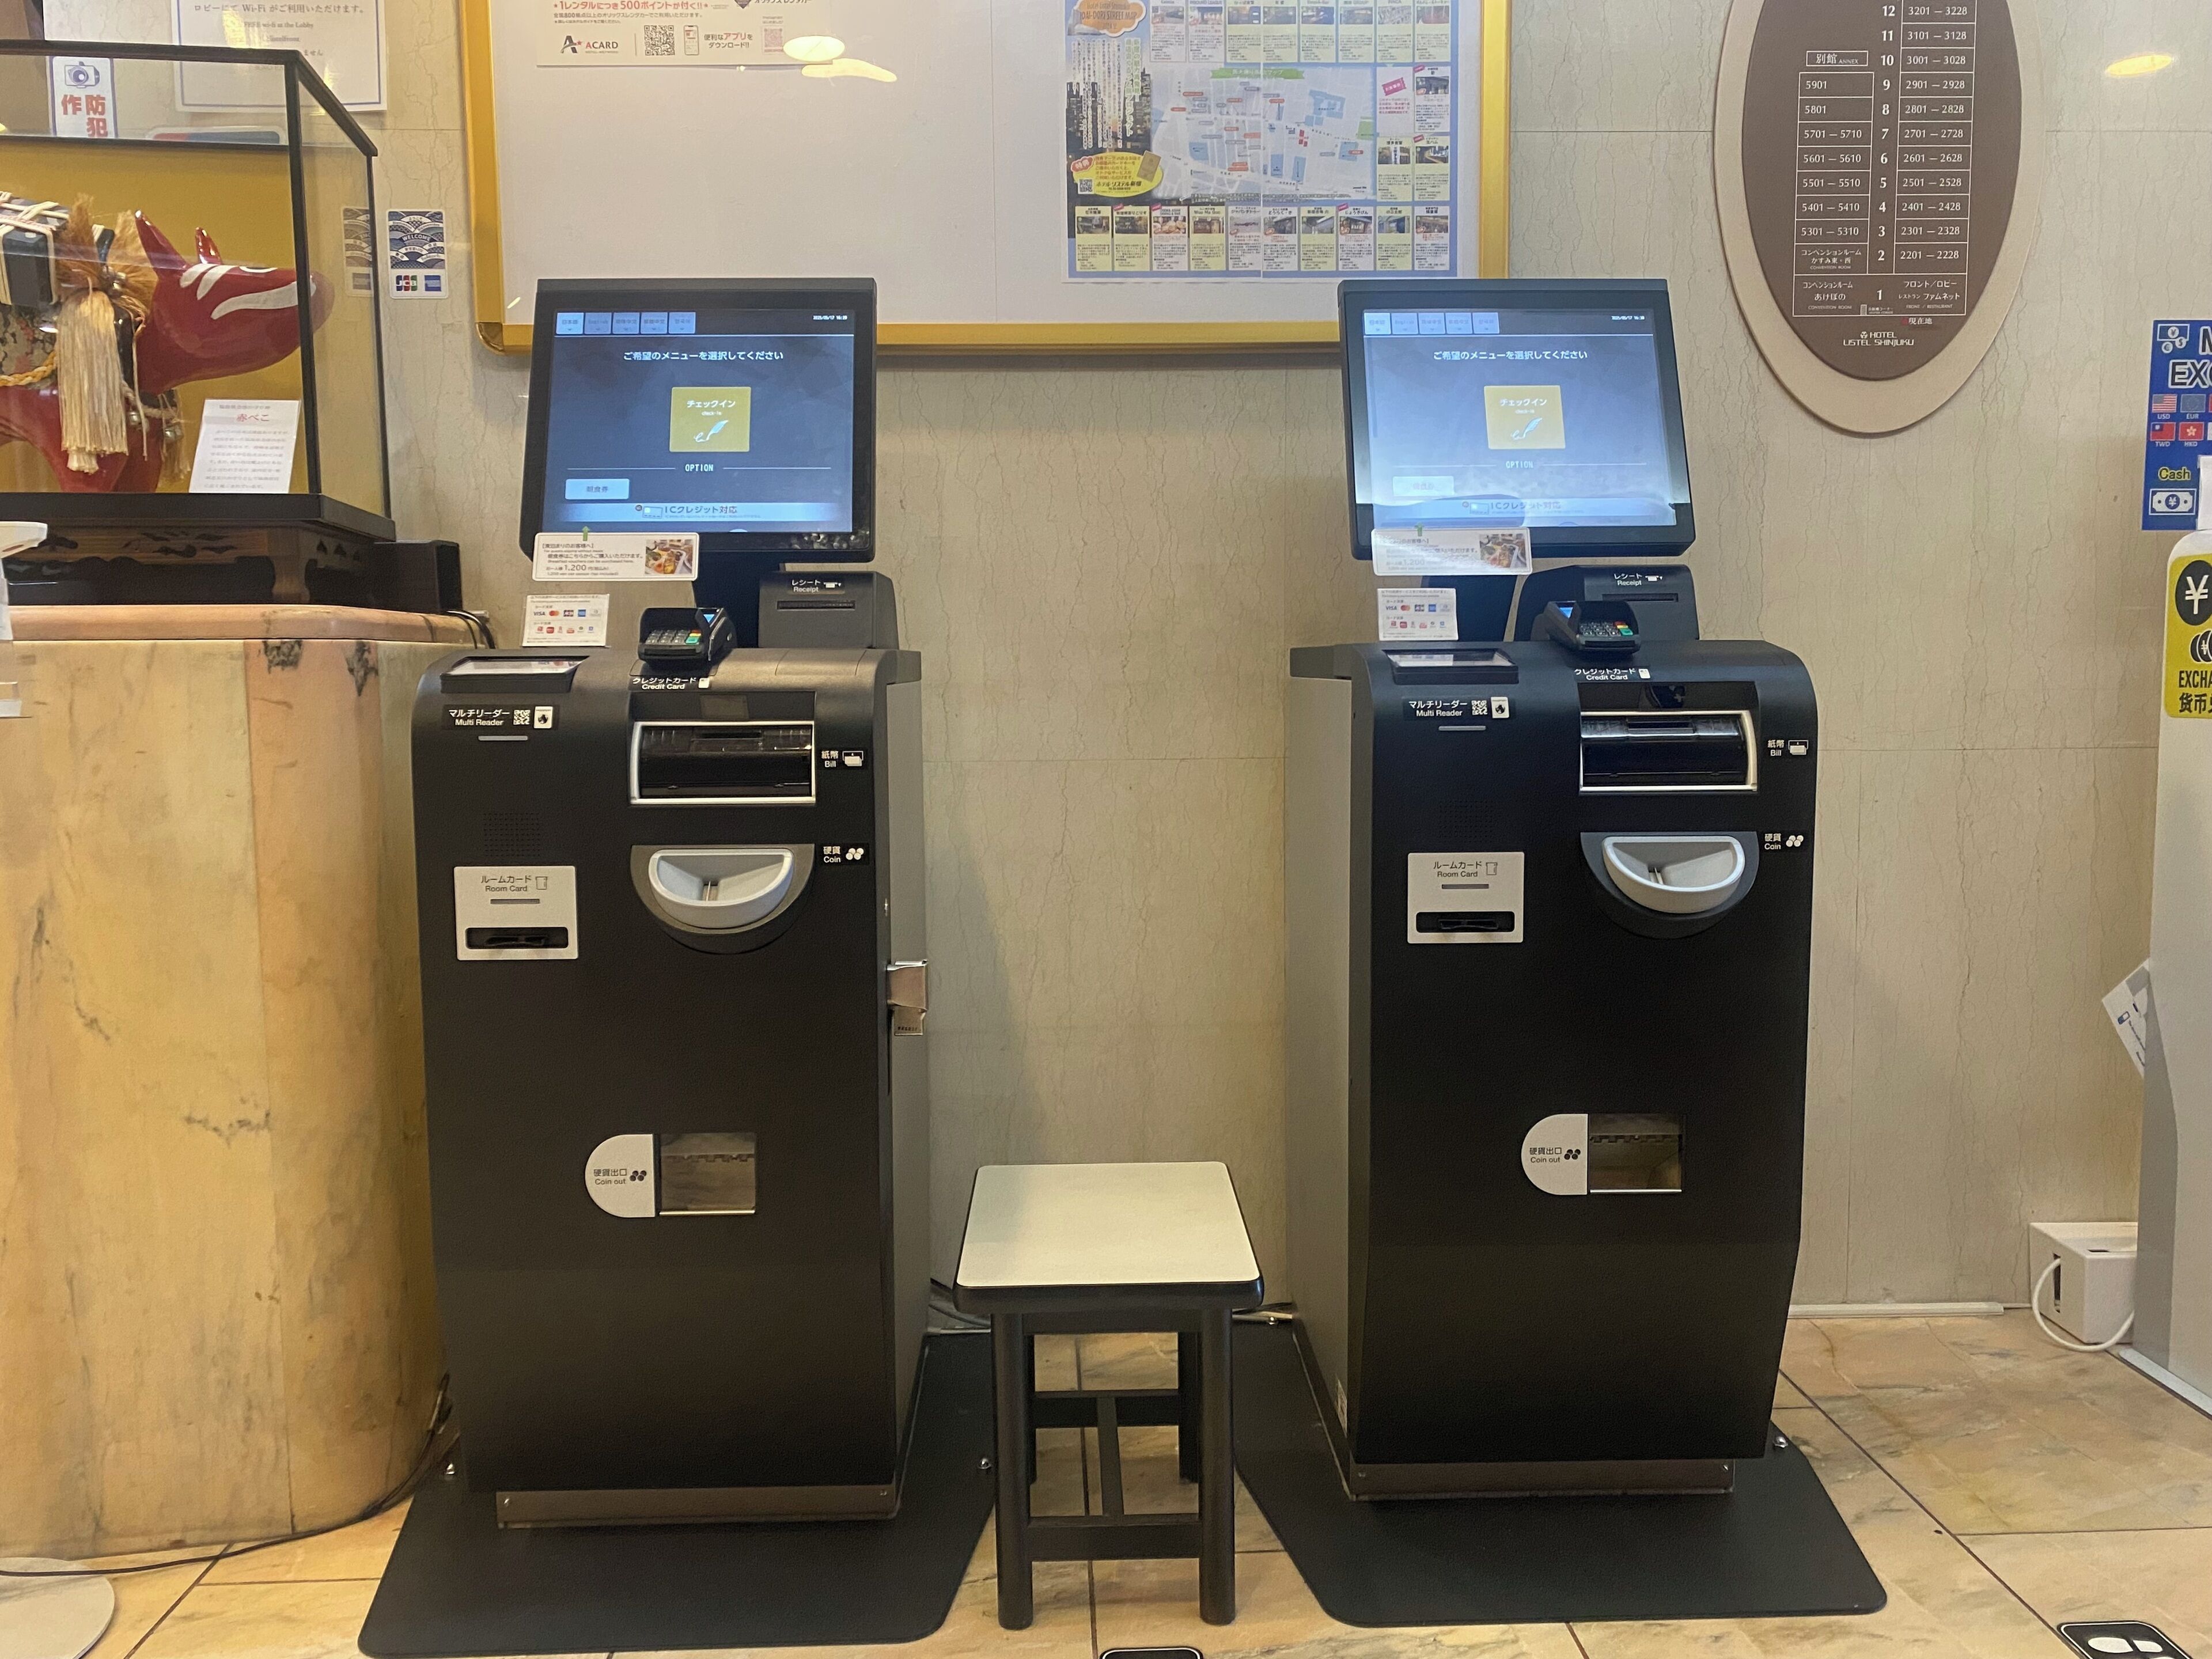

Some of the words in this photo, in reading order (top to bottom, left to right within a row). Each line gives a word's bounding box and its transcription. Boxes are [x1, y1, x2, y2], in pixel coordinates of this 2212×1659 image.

[243, 3, 266, 13] Wi-Fi
[269, 4, 364, 14] がご利用いただけます。
[1882, 5, 1895, 17] 12
[1908, 6, 1930, 16] 3201
[1945, 6, 1967, 16] 3228
[704, 32, 753, 41] 便利なアプリを
[1881, 30, 1893, 41] 11
[1907, 31, 1929, 40] 3101
[1944, 31, 1967, 40] 3128
[1816, 54, 1838, 65] 別館
[1880, 55, 1894, 66] 10
[1906, 55, 1928, 65] 3001
[1943, 55, 1965, 65] 3028
[1805, 80, 1827, 89] 5901
[1883, 79, 1891, 90] 9
[1906, 80, 1927, 89] 2901
[1942, 80, 1965, 89] 2928
[61, 94, 82, 115] 作
[1804, 105, 1827, 114] 5801
[1882, 104, 1890, 115] 8
[1905, 105, 1927, 114] 2801
[1942, 105, 1964, 114] 2828
[85, 94, 108, 138] 防犯
[1804, 130, 1825, 138] 5701
[1840, 130, 1862, 138] 5710
[1881, 128, 1889, 139] 7
[1904, 130, 1926, 138] 2701
[1941, 130, 1964, 138] 2728
[1803, 154, 1825, 163] 5601
[1839, 154, 1861, 163] 5610
[1880, 153, 1888, 164] 6
[1903, 154, 1925, 162] 2601
[1940, 154, 1963, 162] 2628
[1802, 179, 1824, 187] 5501
[1838, 179, 1861, 187] 5510
[1880, 177, 1887, 188] 5
[1903, 178, 1925, 187] 2501
[1939, 178, 1961, 187] 2528
[1802, 203, 1824, 212] 5401
[1838, 203, 1859, 212] 5410
[1878, 202, 1887, 212] 4
[1902, 202, 1923, 211] 2401
[1938, 202, 1961, 211] 2428
[1801, 227, 1823, 236] 5301
[1836, 227, 1859, 236] 5310
[1878, 226, 1885, 237] 3
[1901, 226, 1923, 236] 2301
[1937, 226, 1960, 236] 2328
[1877, 250, 1885, 261] 2
[1900, 251, 1922, 259] 2201
[1937, 251, 1959, 259] 2228
[396, 275, 418, 291] JCB
[1814, 293, 1846, 301] あけぼの
[1876, 289, 1883, 300] 1
[1874, 339, 1914, 347] SHINJUKU
[623, 350, 783, 361] ご希望のメニューを選択してください
[1433, 350, 1588, 361] ご希望のメニューを選択してください
[2169, 361, 2212, 388] EX
[687, 400, 736, 408] チェックイン
[1500, 398, 1547, 407] チェックイン
[236, 414, 270, 422] 赤べこ
[684, 464, 714, 472] OPTION
[2158, 468, 2191, 480] Cash
[664, 505, 738, 514] ICクレジット対応
[1408, 700, 1468, 709] マルチリーダー
[2179, 692, 2212, 714] 货币
[449, 709, 510, 718] マルチリーダー
[455, 718, 475, 726] Multi
[476, 718, 504, 726] Reader
[1767, 739, 1785, 749] 紙幣
[821, 750, 839, 760] 紙幣
[824, 760, 836, 768] Bill
[1764, 833, 1782, 843] 硬貨
[823, 846, 841, 855] 硬貨
[824, 855, 841, 863] Coin
[1433, 861, 1482, 870] ルームカード
[481, 875, 532, 884] ルームカード
[1529, 1147, 1562, 1156] 硬貨出口
[593, 1168, 627, 1177] 硬貨出口
